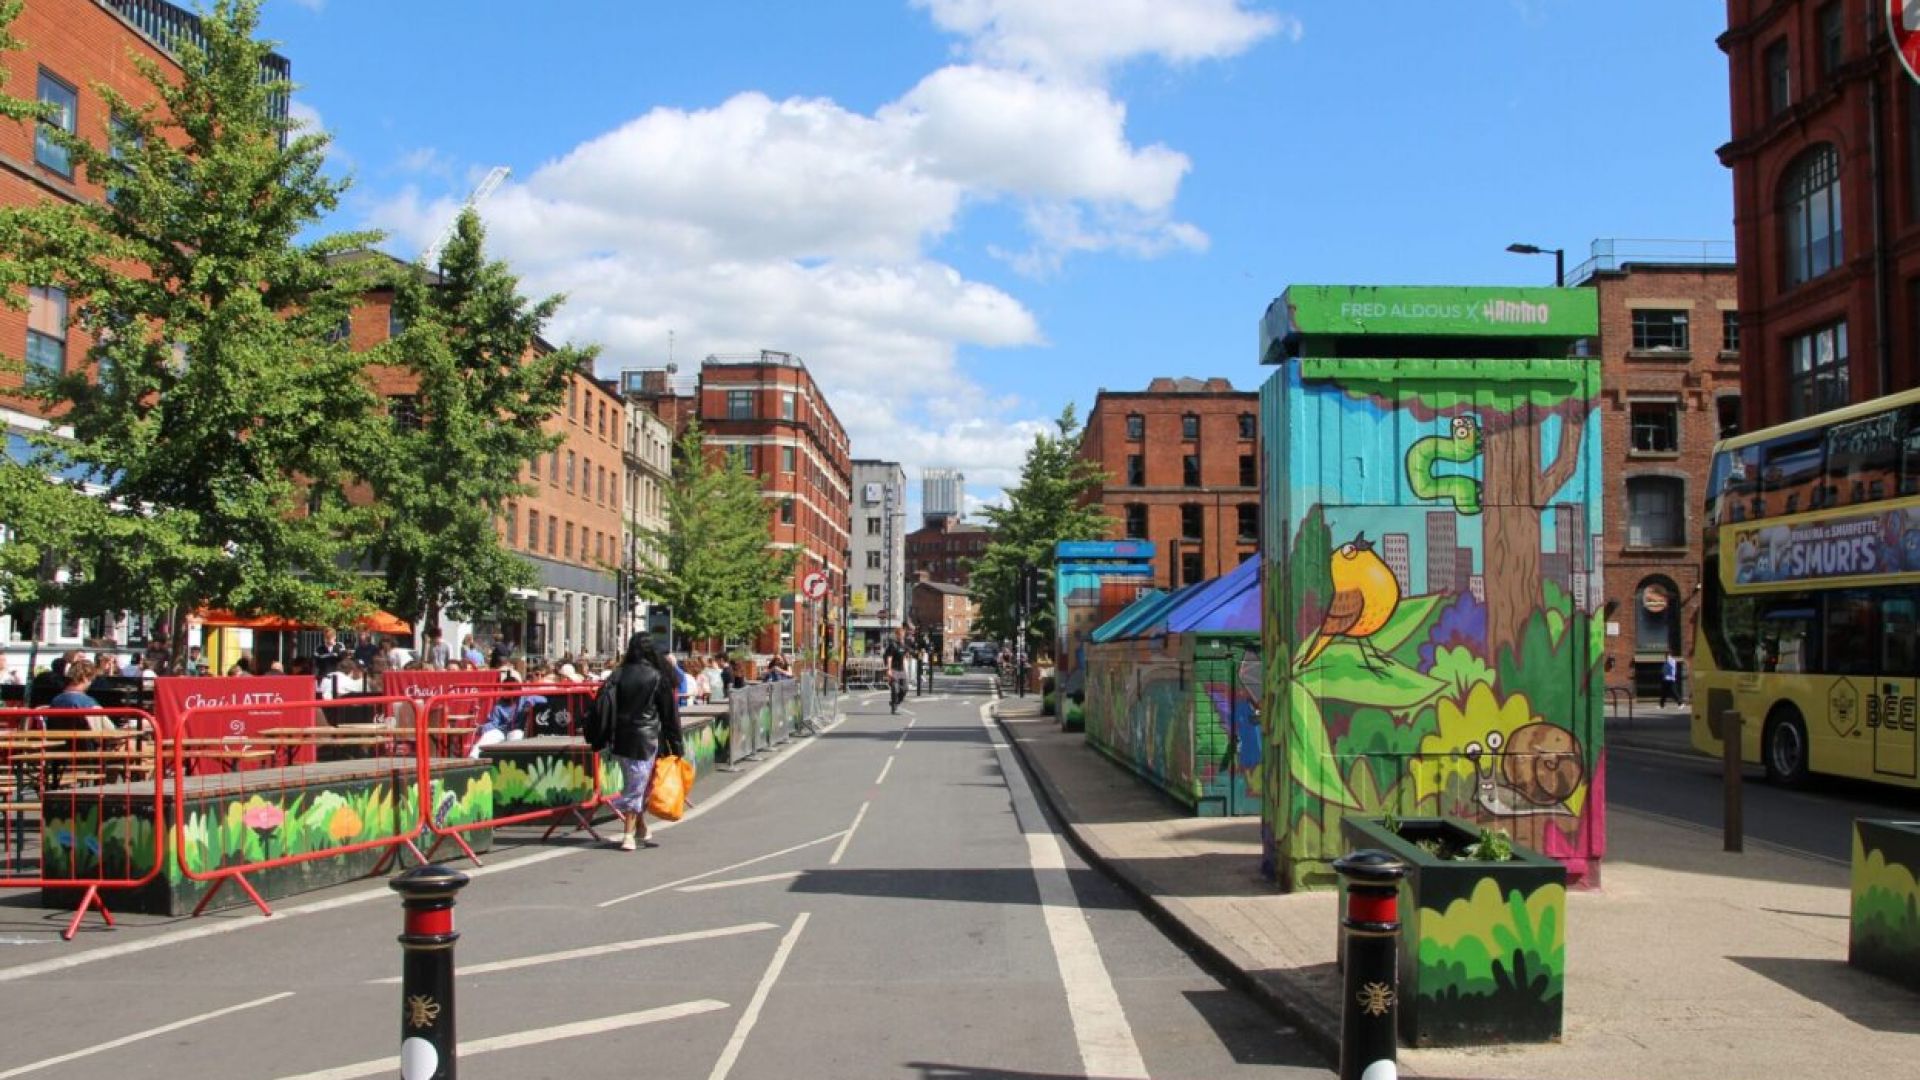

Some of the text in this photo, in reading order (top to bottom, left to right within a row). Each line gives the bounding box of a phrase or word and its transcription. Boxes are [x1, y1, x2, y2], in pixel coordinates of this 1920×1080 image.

[1340, 303, 1386, 318] FRED
[1391, 303, 1462, 318] ALDOUS
[1791, 535, 1877, 576] SMURFS
[1865, 694, 1916, 731] BEE
